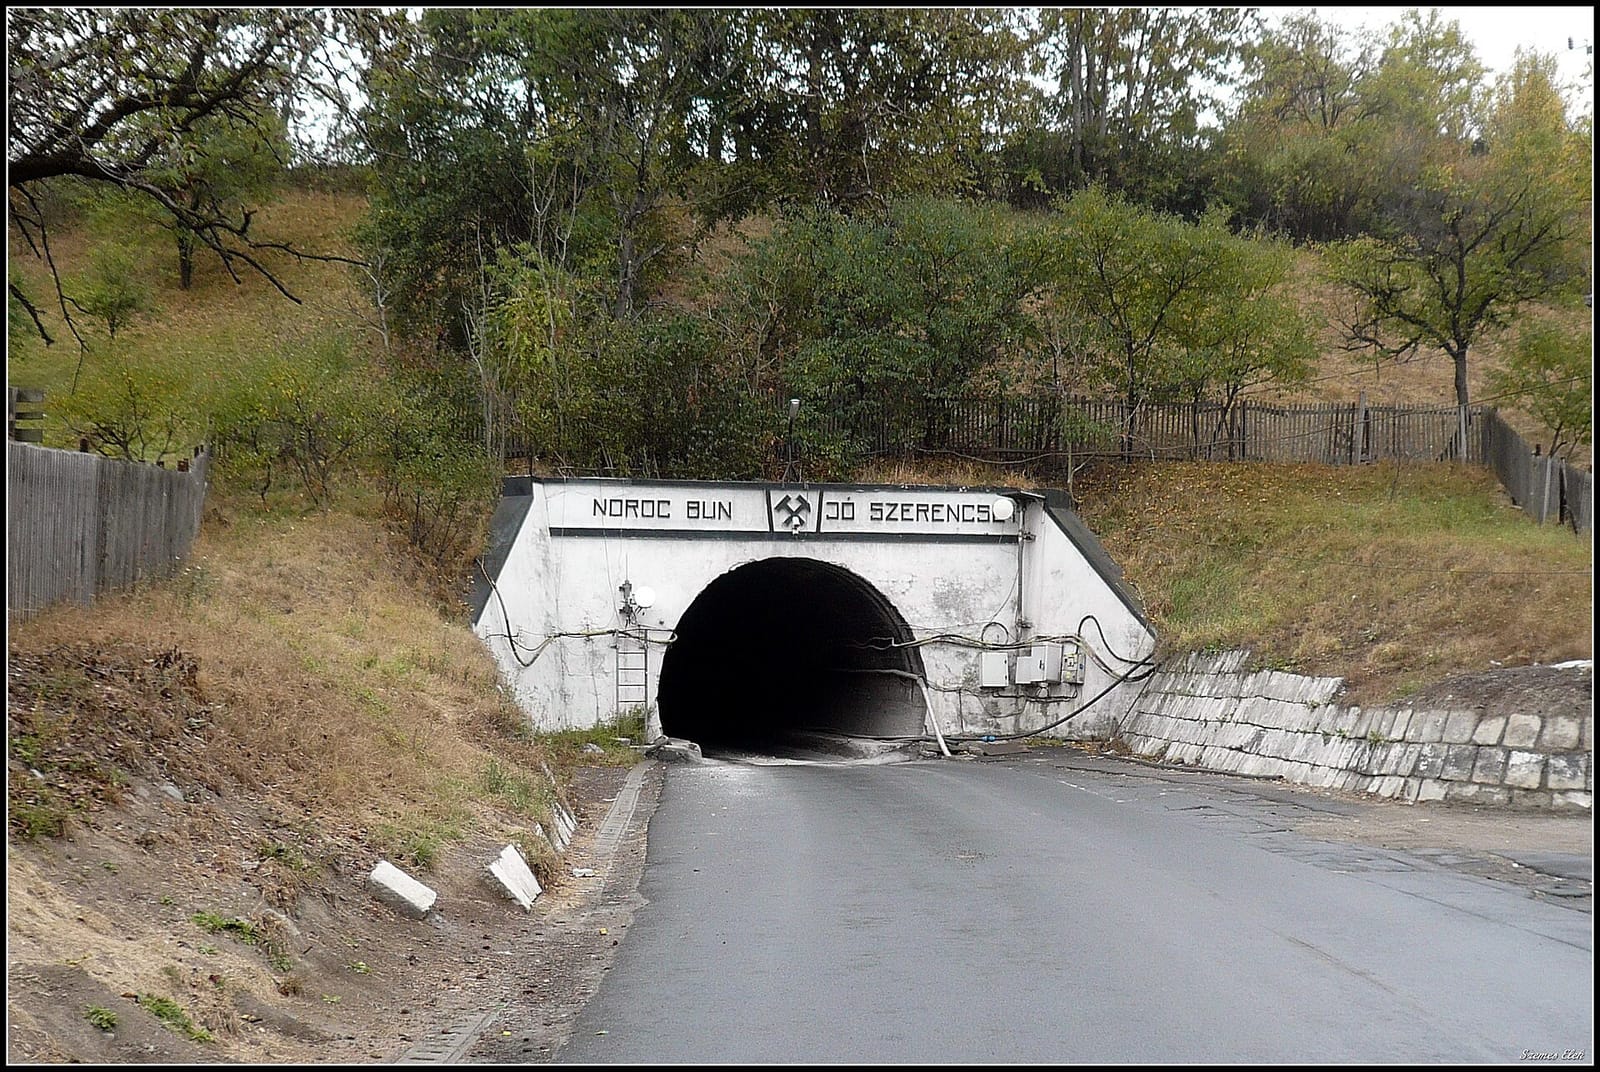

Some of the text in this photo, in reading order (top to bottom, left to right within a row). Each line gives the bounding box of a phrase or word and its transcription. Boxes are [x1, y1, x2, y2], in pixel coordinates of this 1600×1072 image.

[592, 498, 732, 520] NOROC BUN
[825, 496, 1016, 523] JÓ SZERENCS
